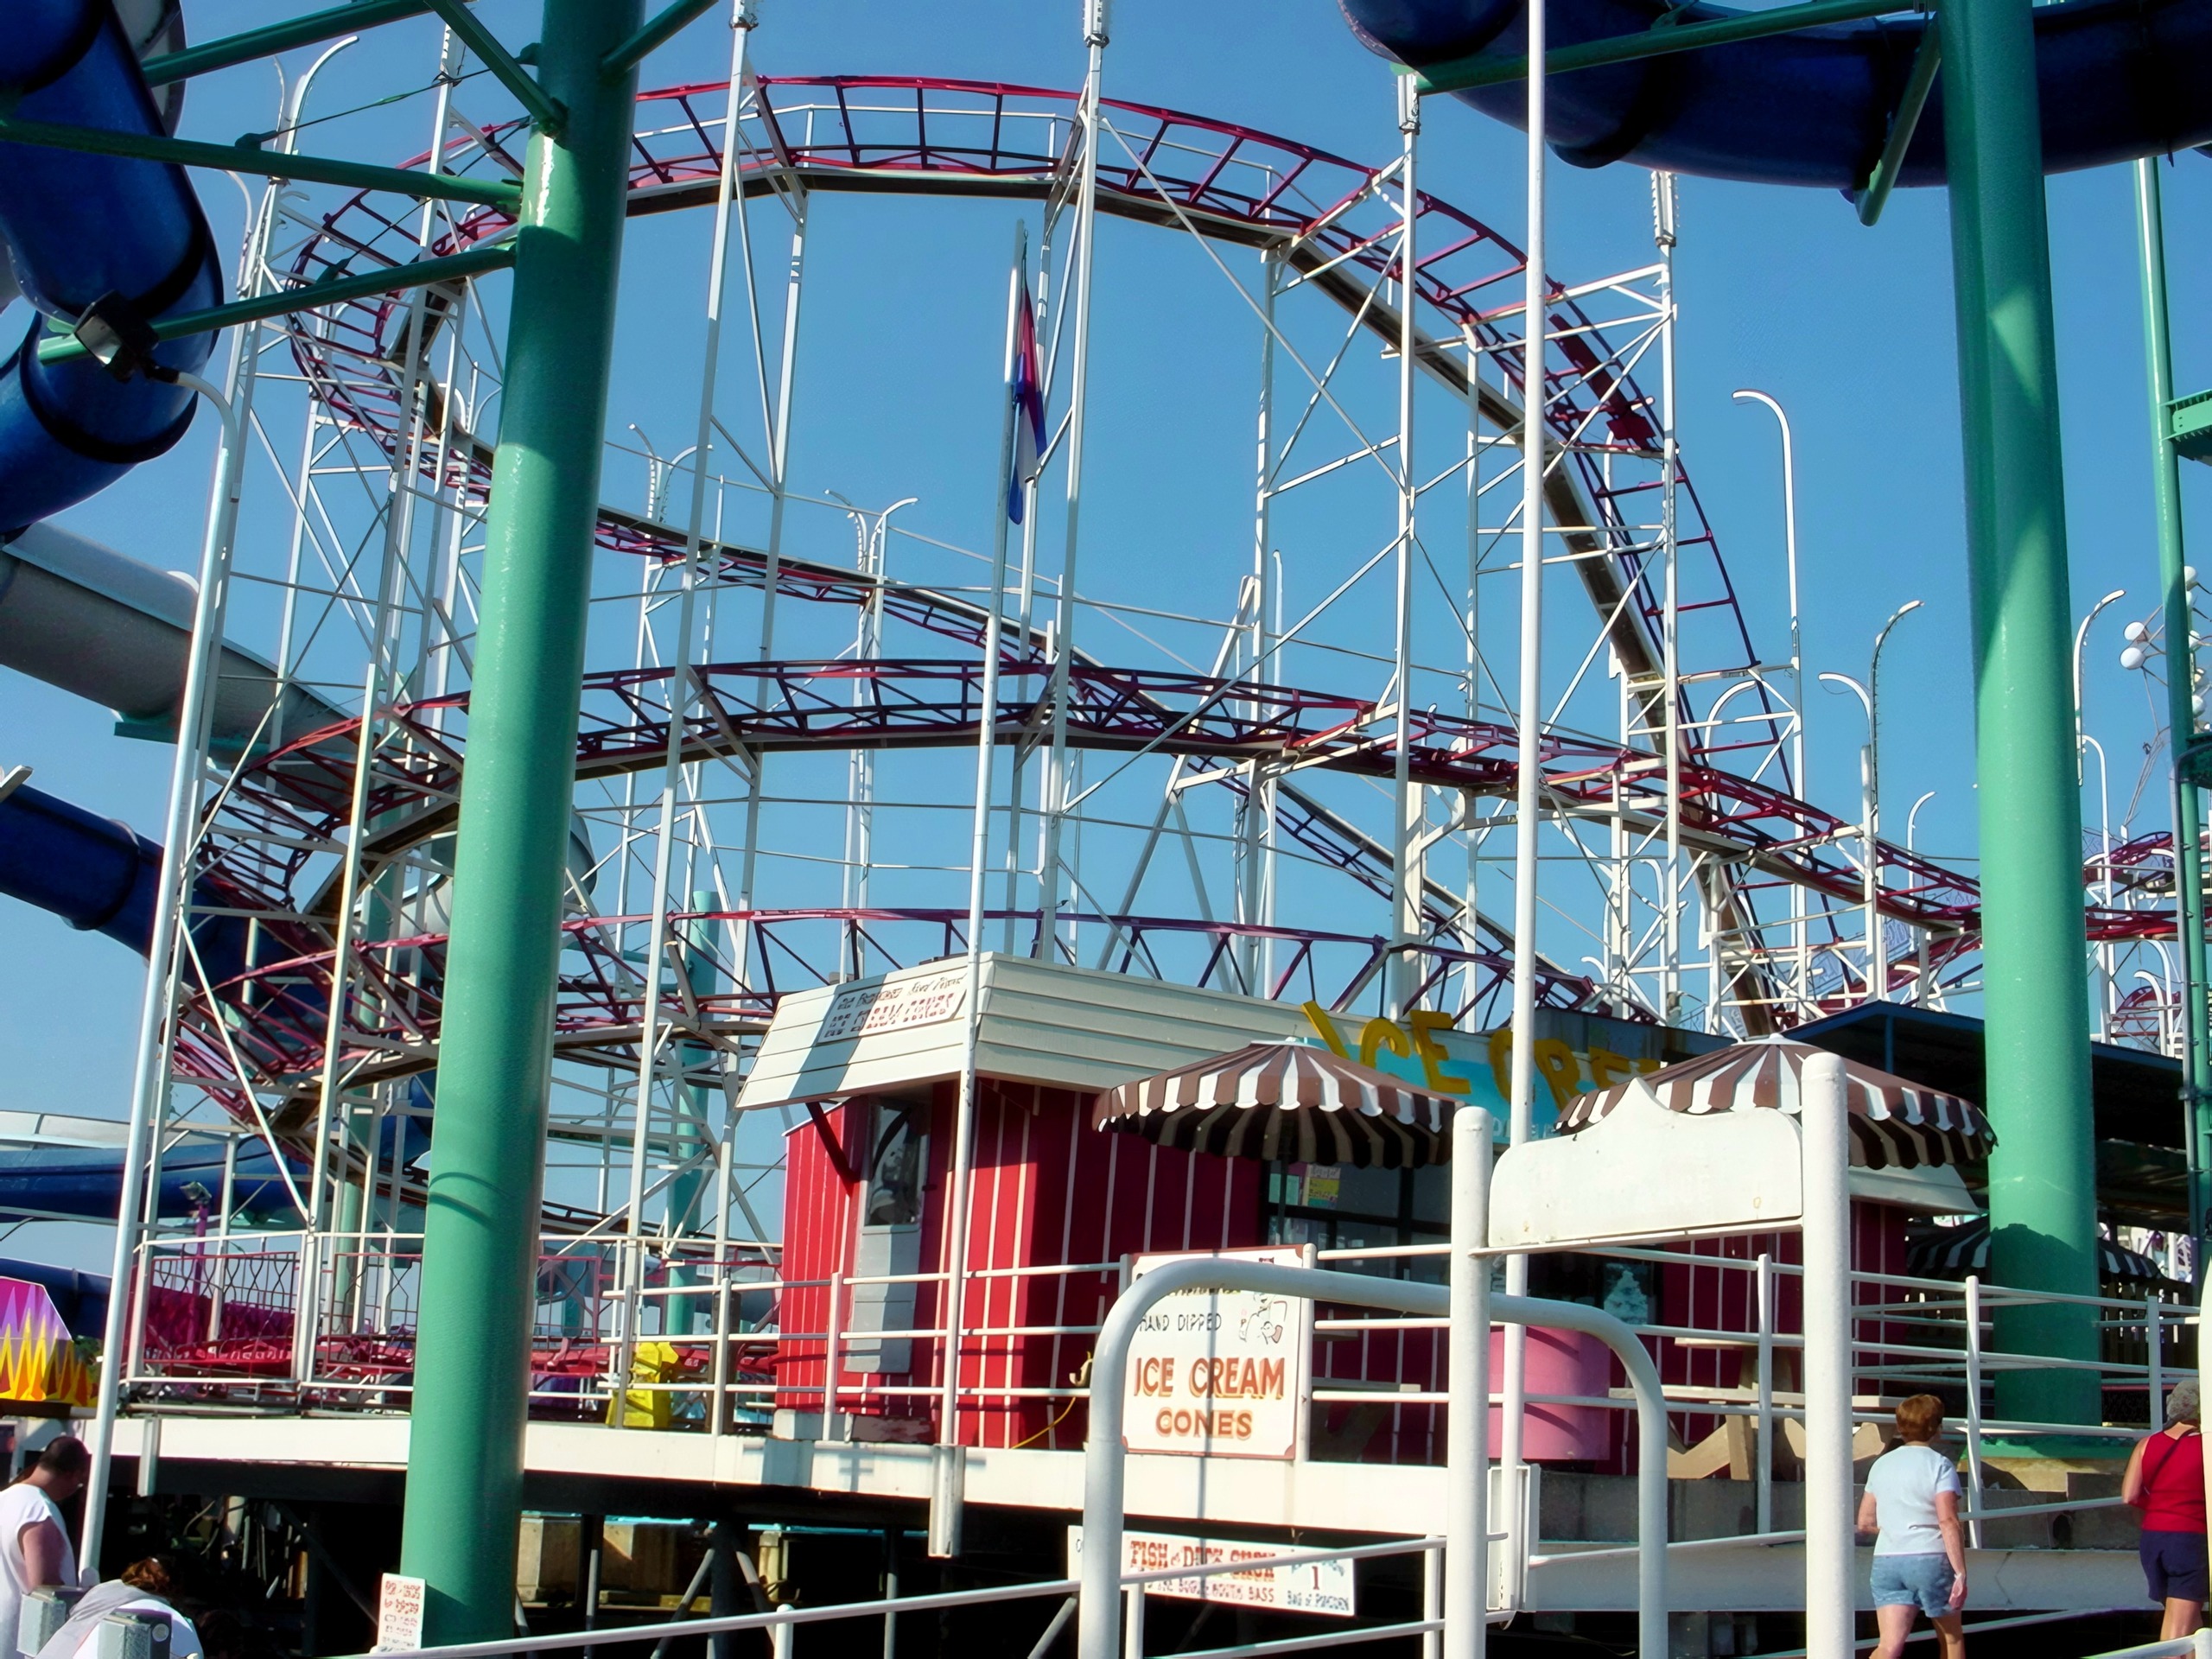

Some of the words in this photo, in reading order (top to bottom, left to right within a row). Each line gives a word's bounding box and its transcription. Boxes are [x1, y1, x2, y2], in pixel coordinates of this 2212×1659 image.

[1300, 1000, 1472, 1094] ICE
[1489, 1027, 1661, 1113] CRE
[1177, 1313, 1222, 1332] DIPPED
[1133, 1357, 1175, 1398] ICE
[1188, 1357, 1286, 1401] CREAM
[1155, 1407, 1254, 1440] CONES
[1130, 1541, 1169, 1570] FISH
[1249, 1586, 1275, 1604] BASS
